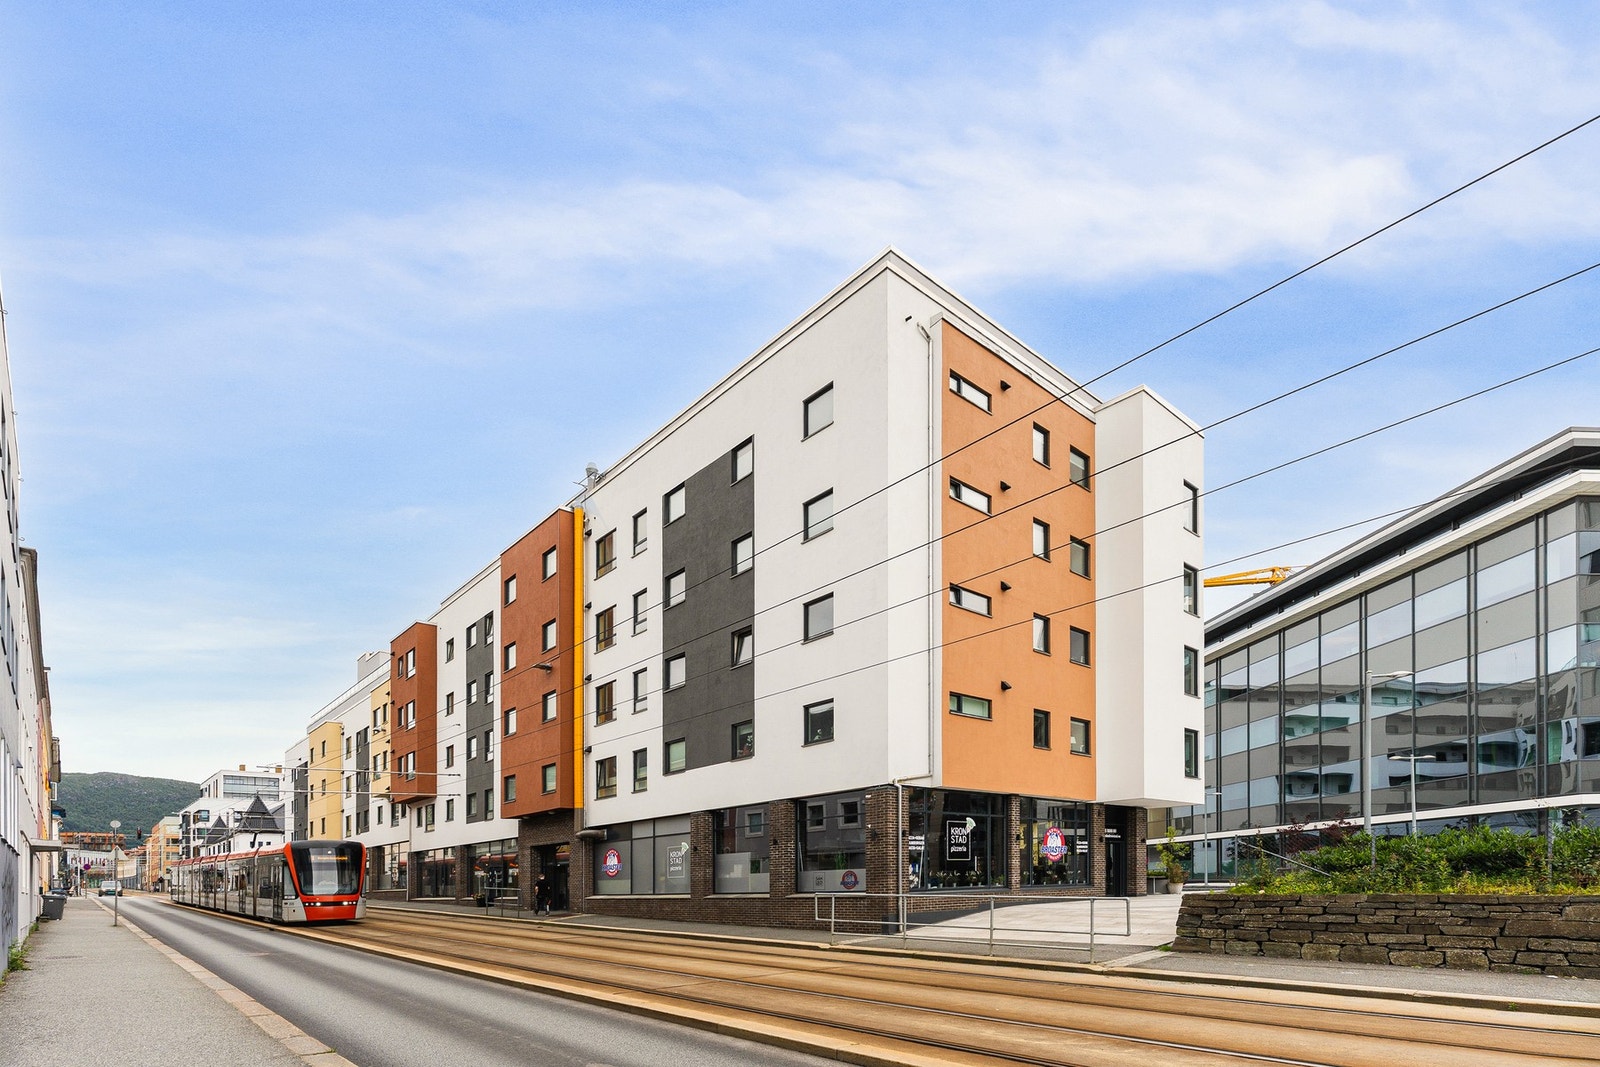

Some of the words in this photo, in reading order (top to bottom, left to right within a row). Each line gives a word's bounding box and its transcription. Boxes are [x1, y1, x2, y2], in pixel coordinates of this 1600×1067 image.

[951, 827, 967, 835] KRON
[951, 836, 967, 844] STAD
[1040, 846, 1068, 854] BROASTER
